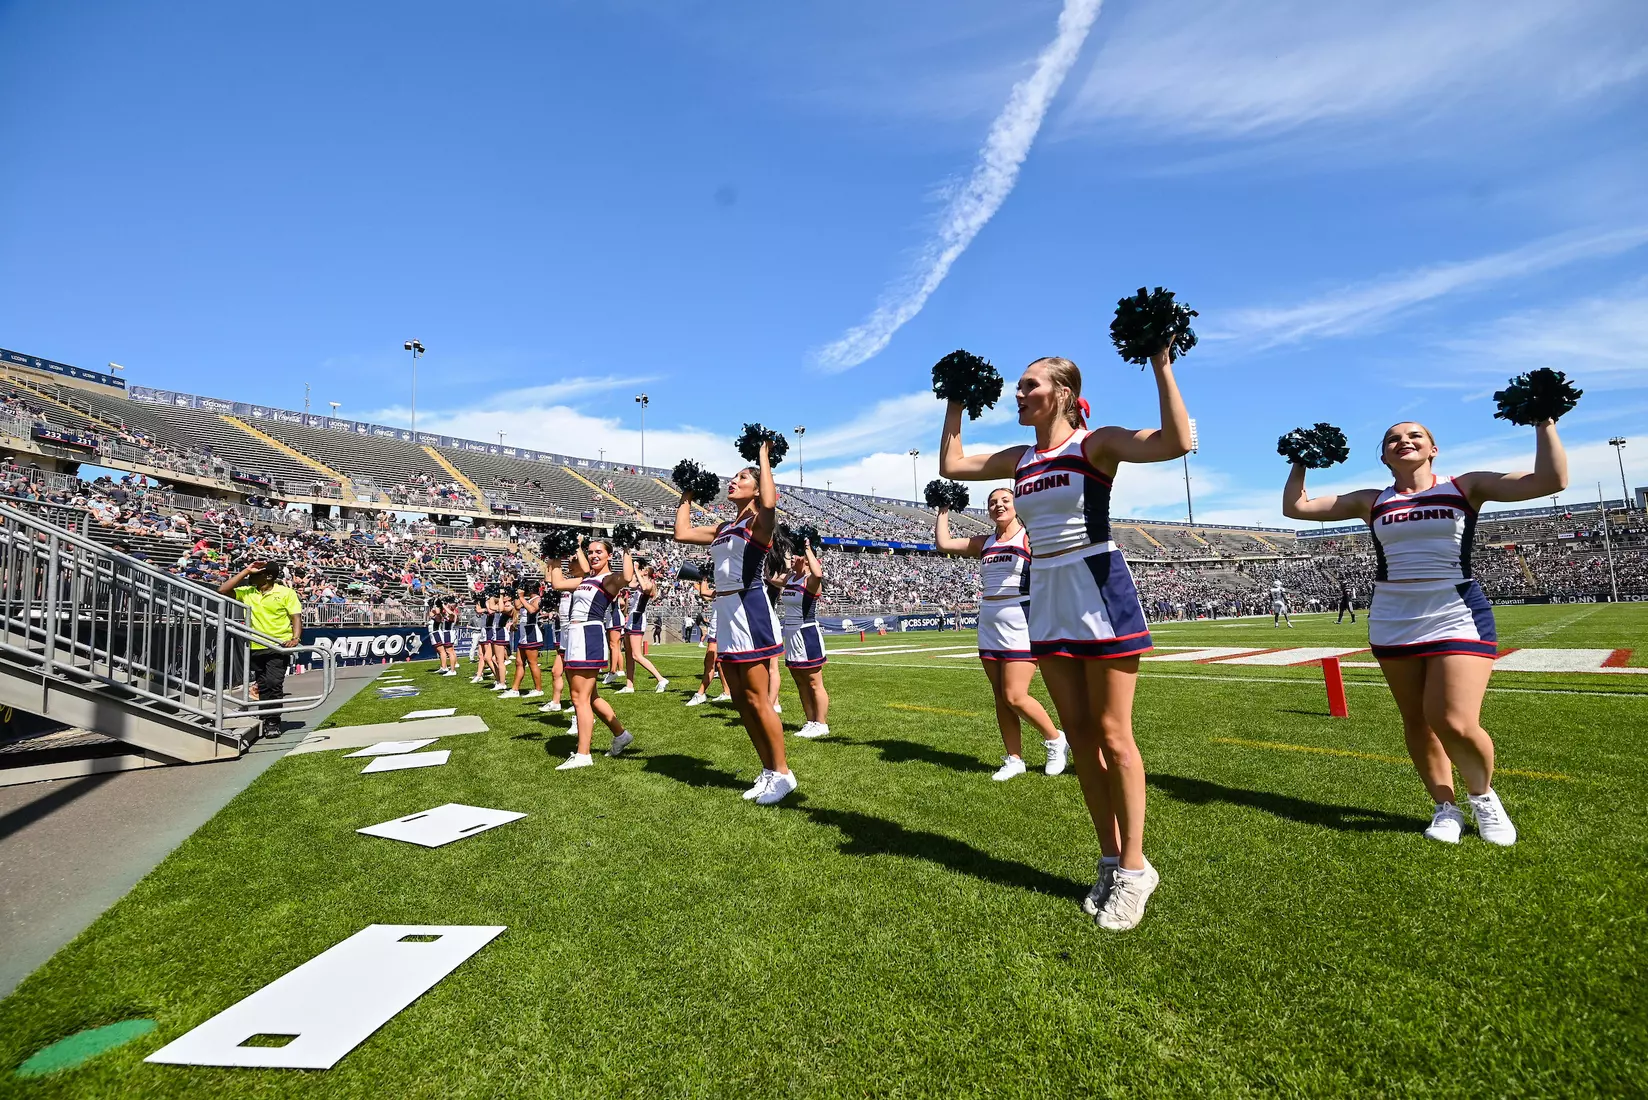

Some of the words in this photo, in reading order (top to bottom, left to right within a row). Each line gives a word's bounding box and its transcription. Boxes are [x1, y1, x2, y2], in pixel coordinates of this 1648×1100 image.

[11, 355, 27, 363] UCONN
[49, 364, 64, 372] UCONN
[202, 400, 230, 410] UCONN
[45, 431, 62, 439] 232
[77, 437, 92, 445] 231
[1015, 473, 1071, 498] UCONN
[1381, 509, 1455, 526] UCONN
[982, 555, 1013, 565] UCONN
[911, 618, 922, 627] CBS
[922, 616, 947, 626] SPORS
[947, 616, 977, 625] NEWORK
[311, 634, 404, 661] DATTCO
